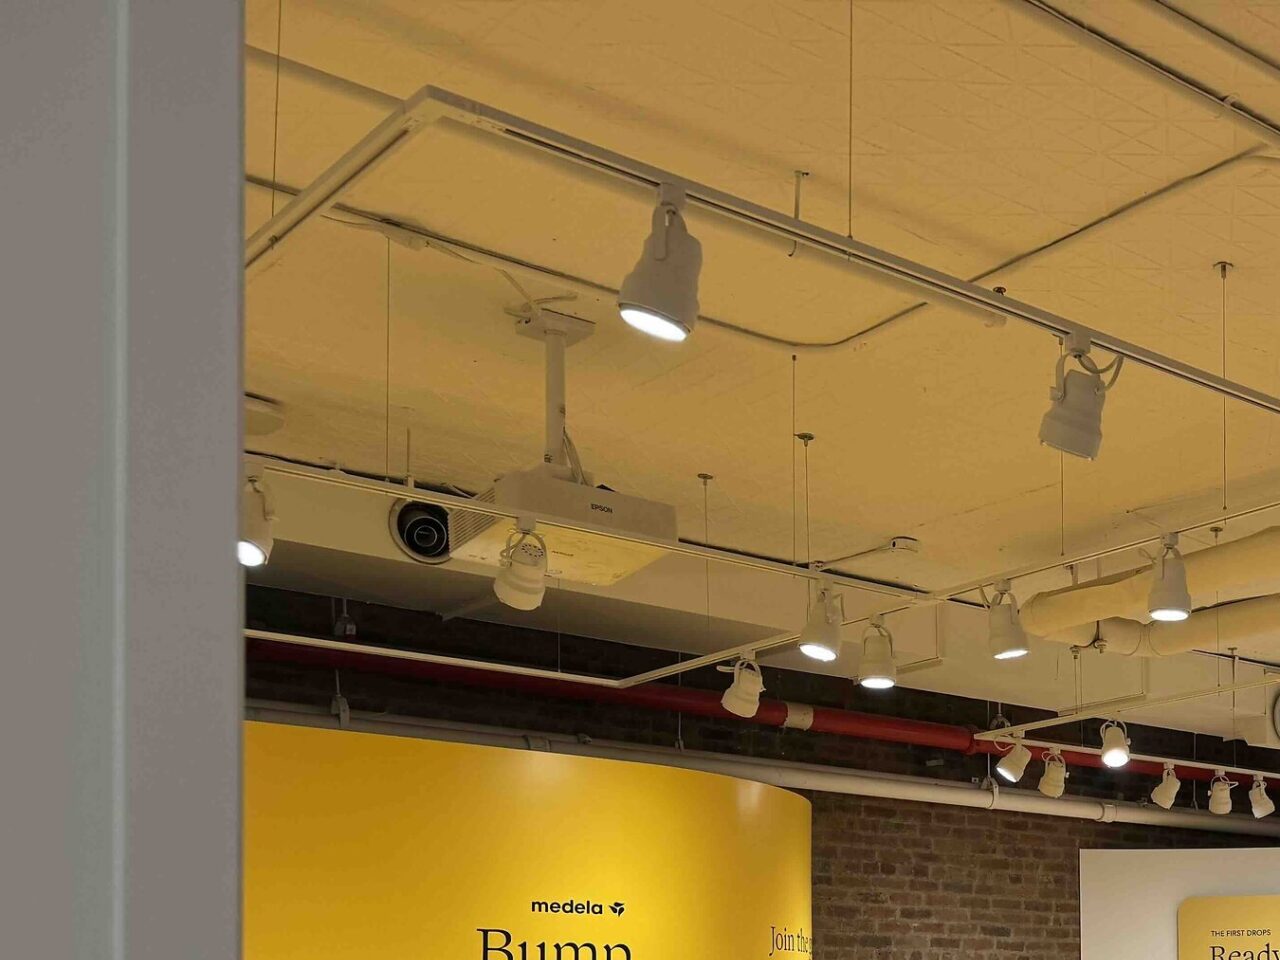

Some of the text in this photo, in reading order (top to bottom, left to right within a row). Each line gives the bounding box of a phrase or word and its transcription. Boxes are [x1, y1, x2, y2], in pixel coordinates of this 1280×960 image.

[591, 503, 613, 514] EPSON
[531, 900, 603, 915] medela
[769, 926, 795, 957] Join
